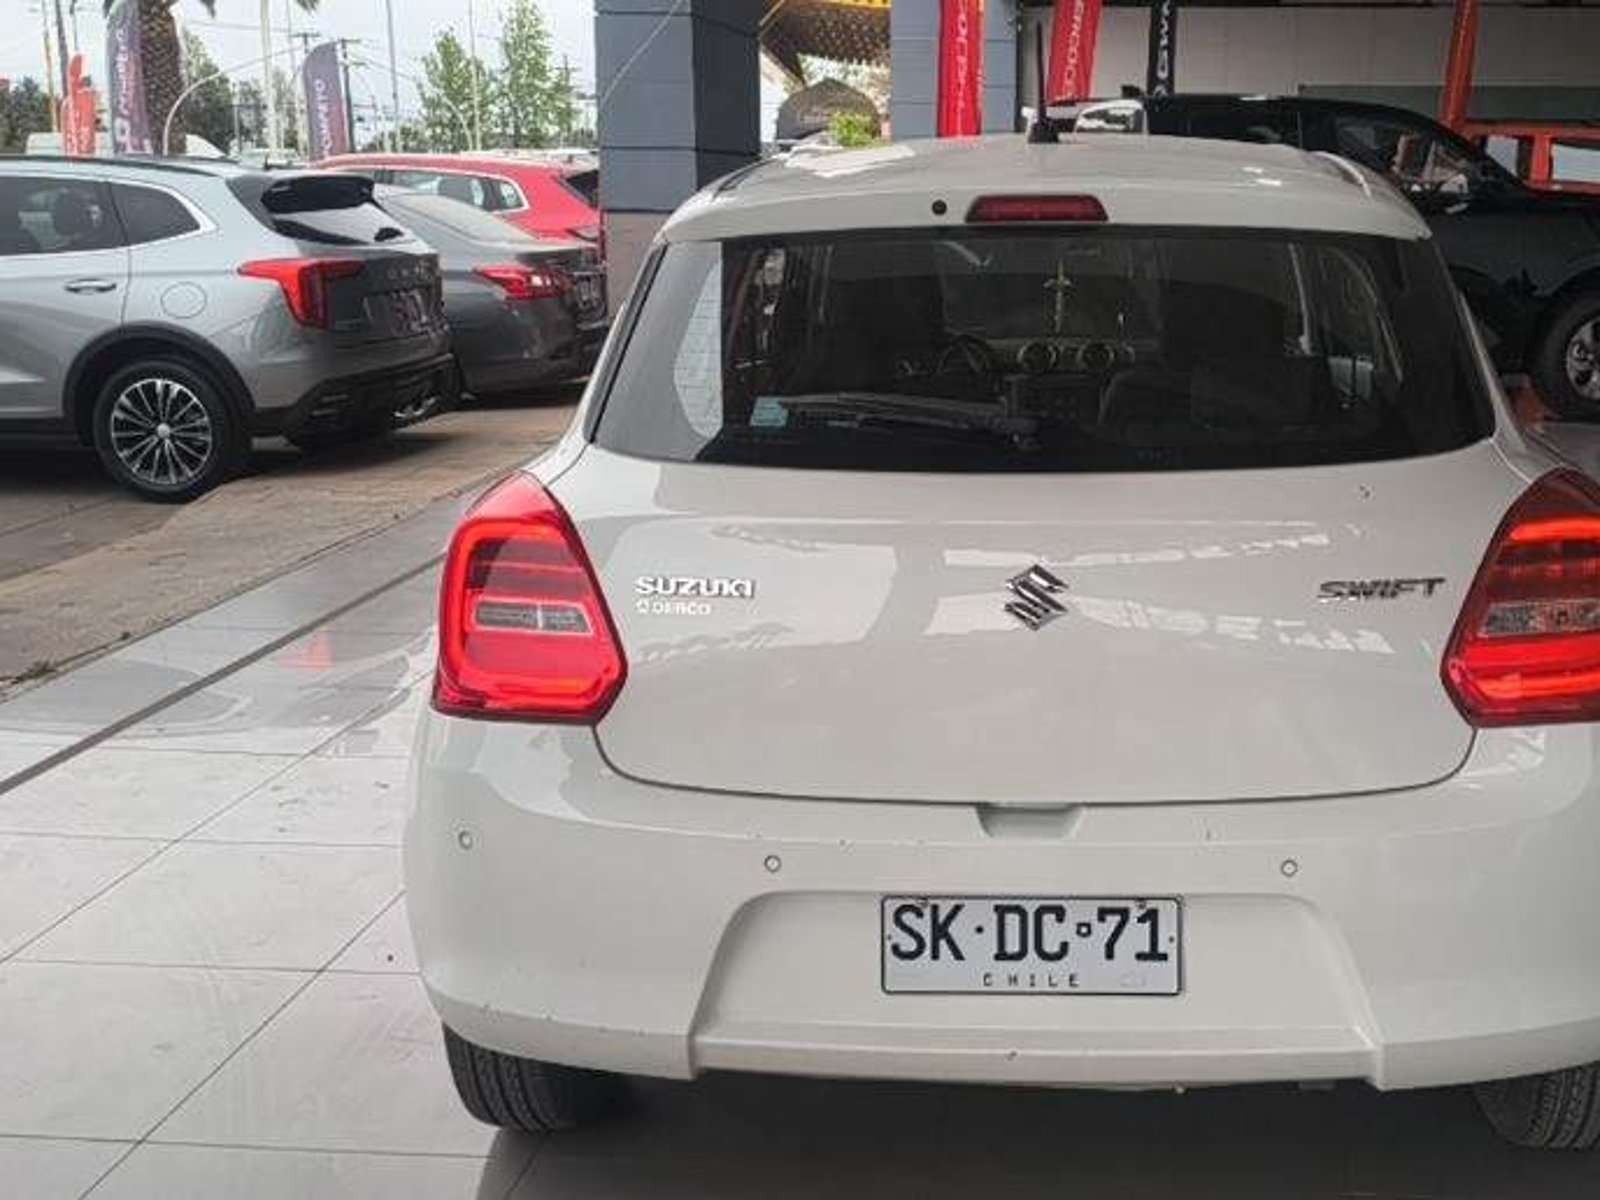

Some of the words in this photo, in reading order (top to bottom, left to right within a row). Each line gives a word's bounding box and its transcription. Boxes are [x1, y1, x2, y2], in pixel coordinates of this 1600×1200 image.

[634, 575, 755, 598] SUZUKI
[1317, 576, 1446, 600] SWIFT
[983, 973, 1080, 988] CHILE
